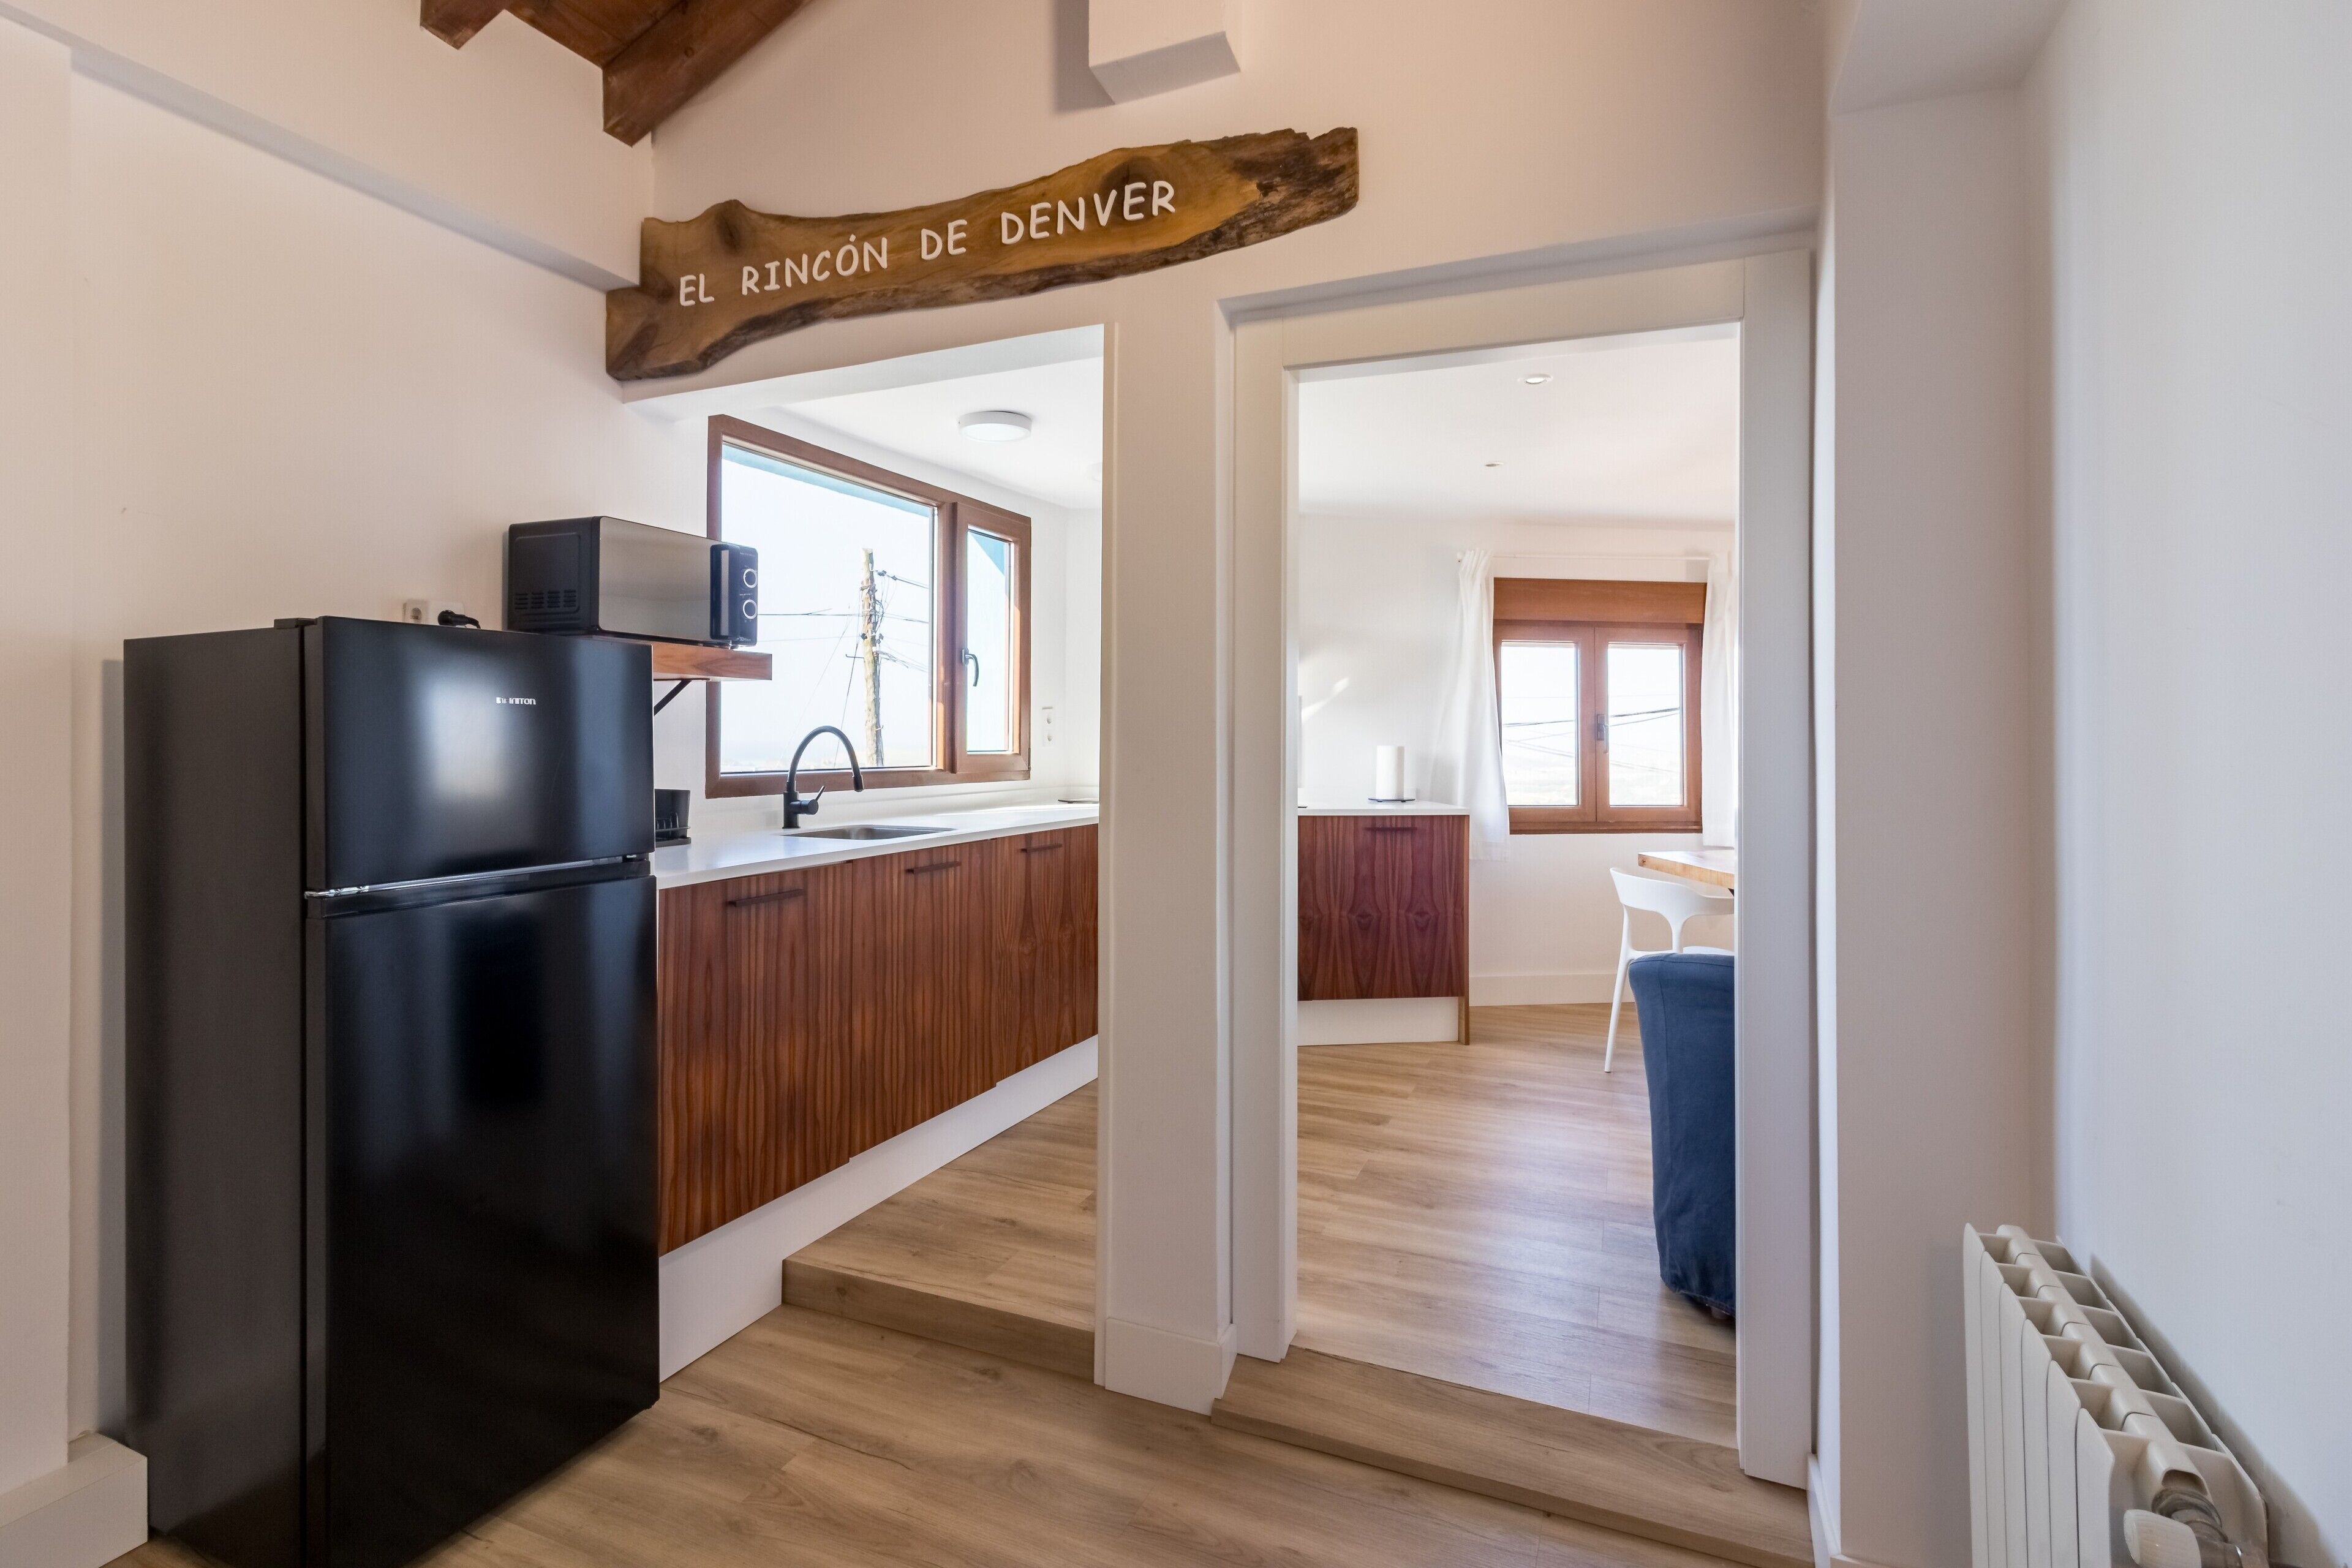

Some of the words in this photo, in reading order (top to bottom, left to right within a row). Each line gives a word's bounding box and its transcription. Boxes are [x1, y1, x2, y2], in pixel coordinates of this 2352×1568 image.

[679, 274, 715, 307] EL
[741, 234, 888, 296] RINCÓN
[920, 219, 968, 262] DE
[1001, 180, 1176, 245] DENVER
